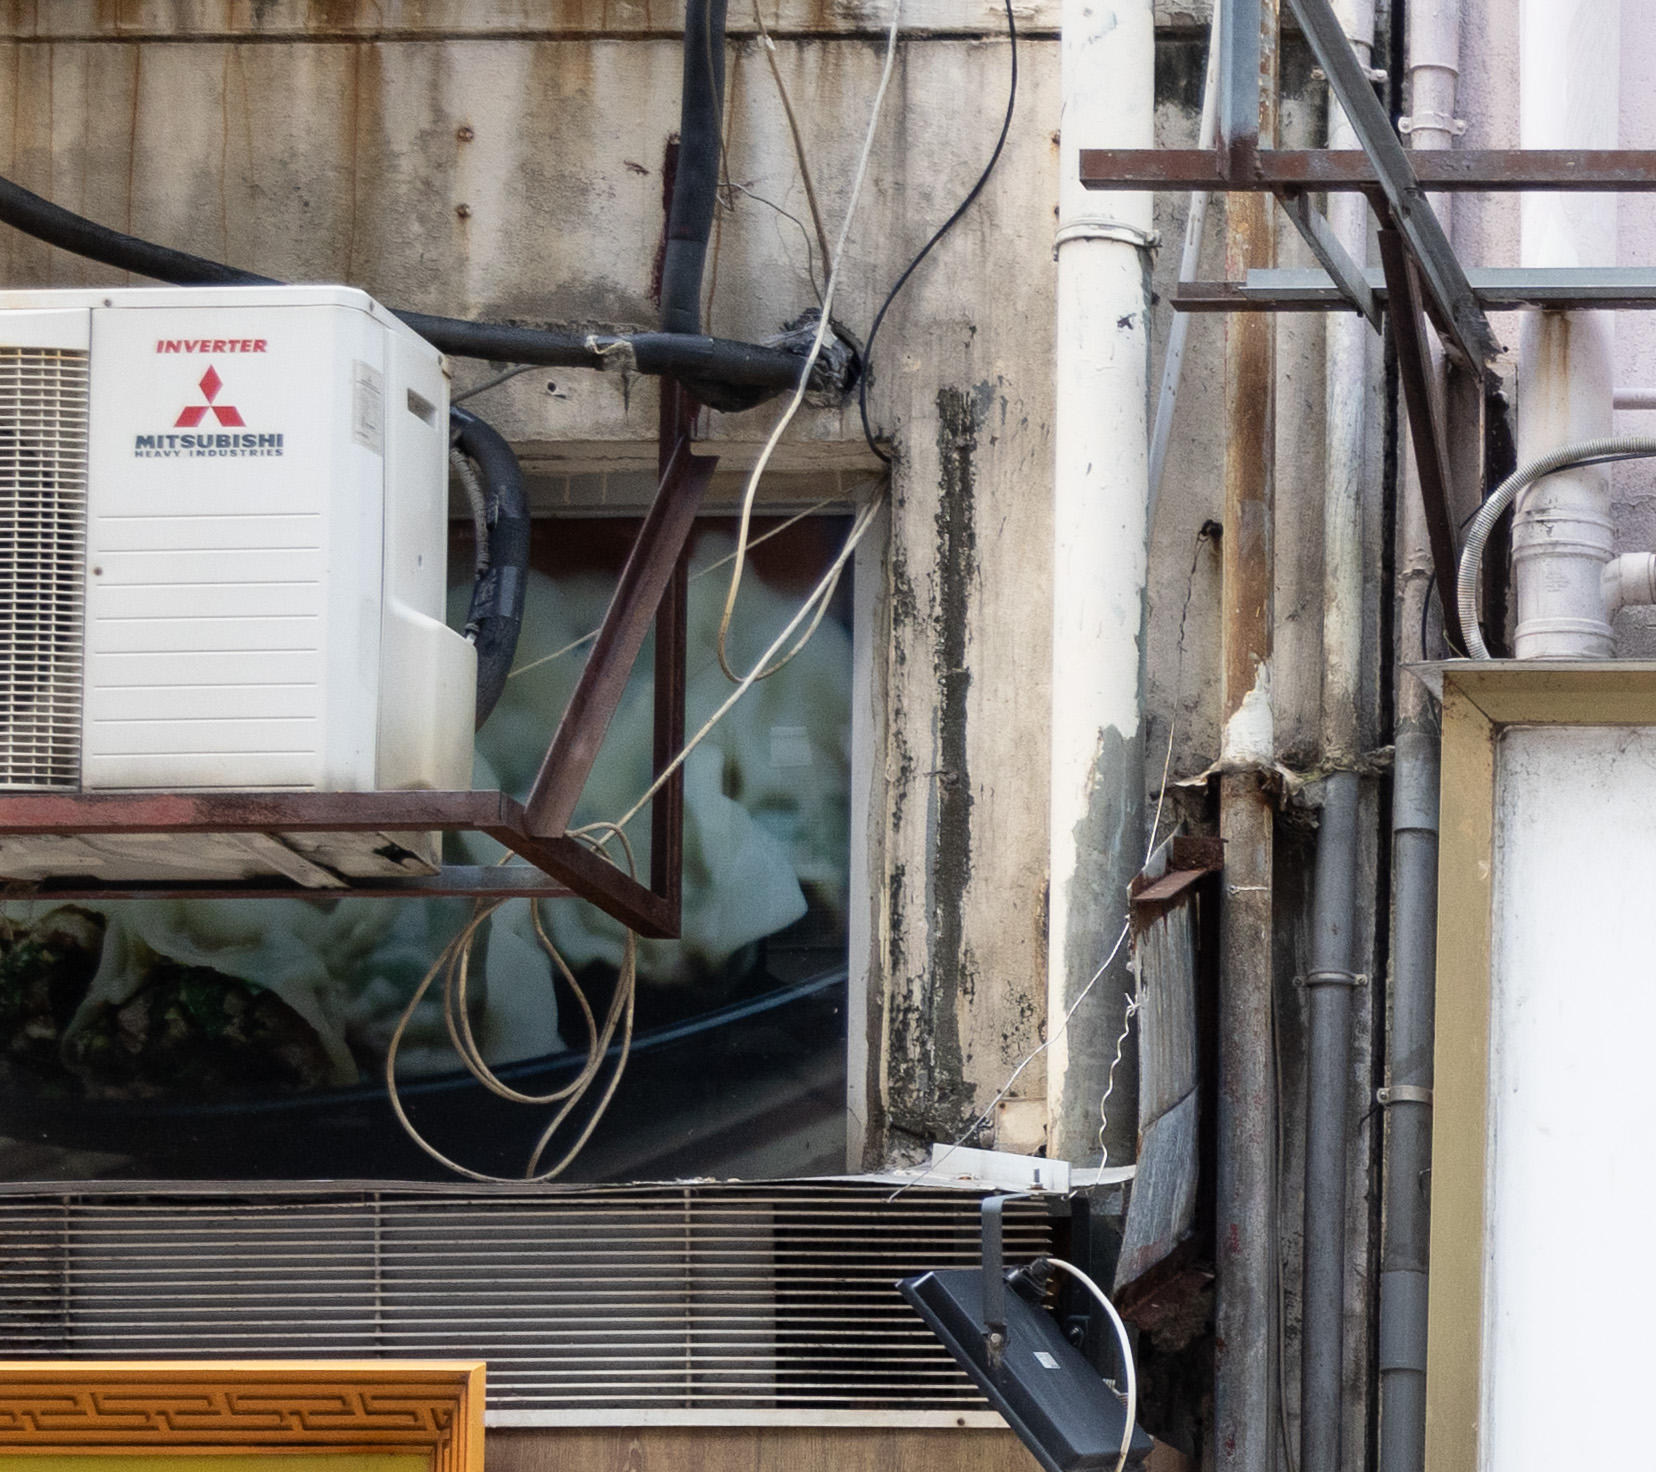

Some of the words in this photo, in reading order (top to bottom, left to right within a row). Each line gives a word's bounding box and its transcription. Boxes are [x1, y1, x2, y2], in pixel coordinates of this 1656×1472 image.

[156, 339, 268, 354] INVERTER
[134, 433, 284, 448] MITSUBISHI
[134, 448, 181, 458] HEAVY
[187, 448, 283, 458] INDUSTRIES
